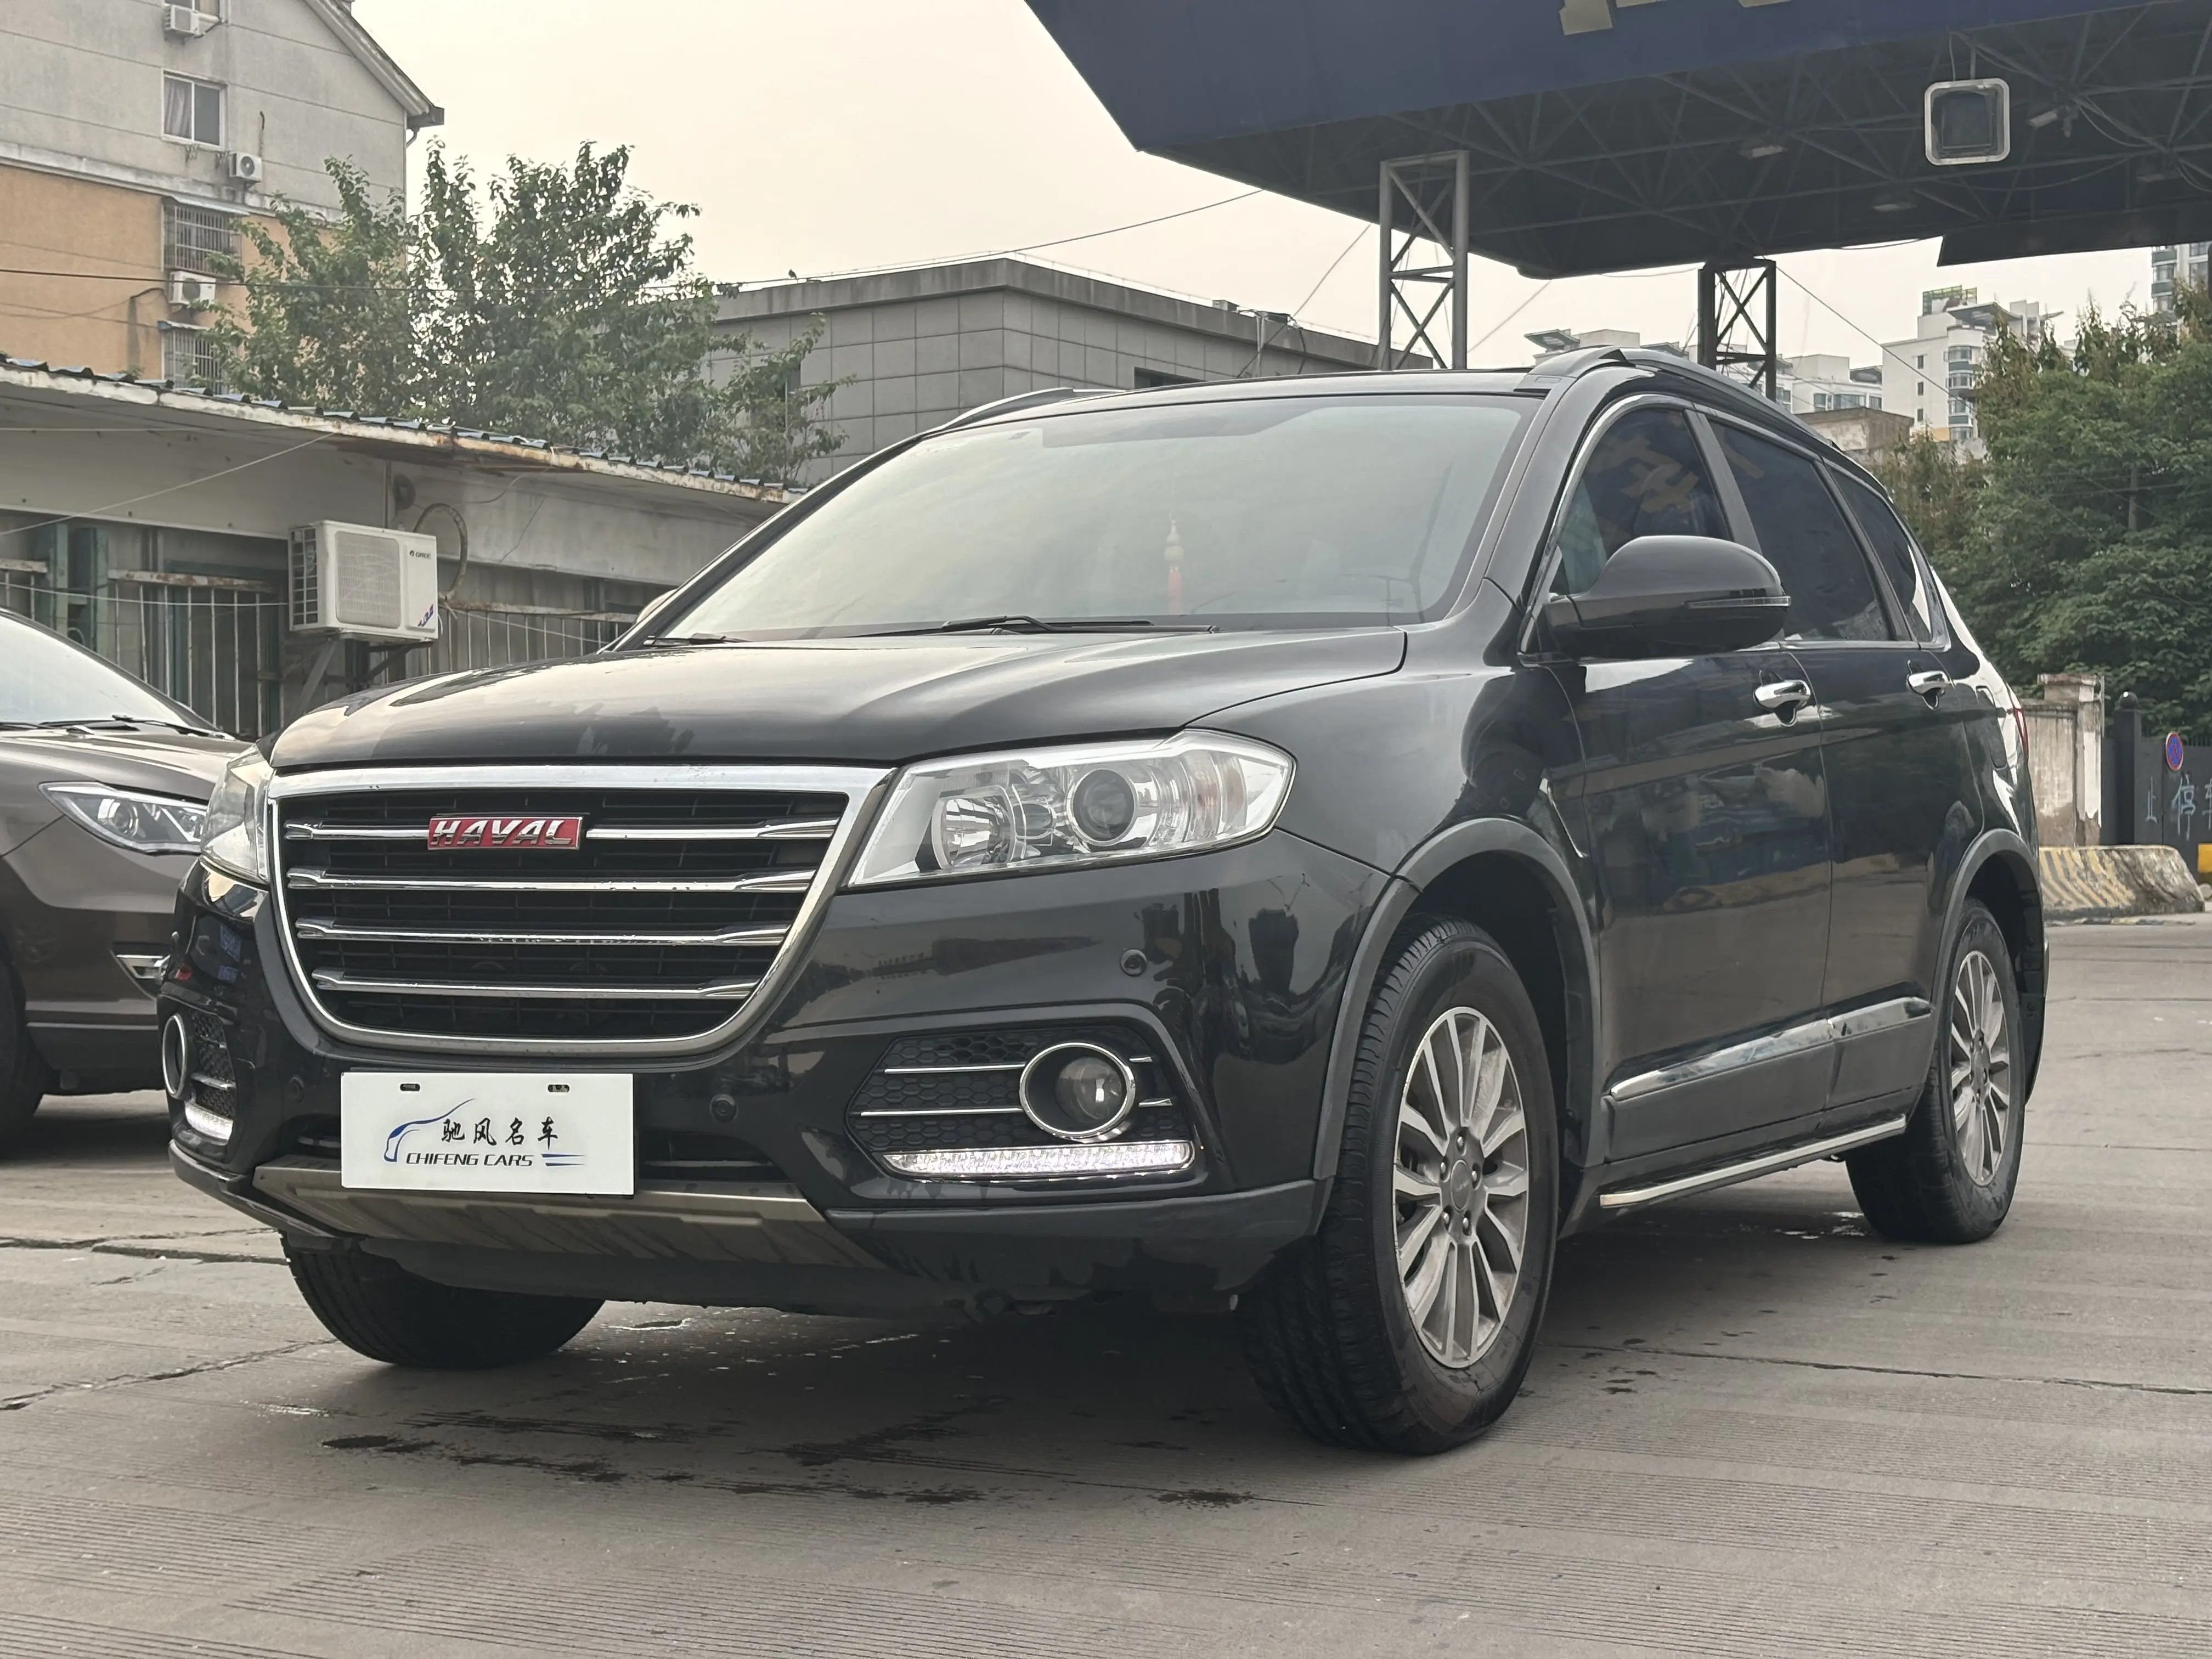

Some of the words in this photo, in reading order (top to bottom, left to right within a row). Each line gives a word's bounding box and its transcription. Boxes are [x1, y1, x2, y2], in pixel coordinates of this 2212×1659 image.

[431, 820, 572, 846] HAVAL
[441, 1116, 558, 1151] 驰风名车
[406, 1152, 479, 1166] CHIFENG
[483, 1154, 534, 1167] CARS
